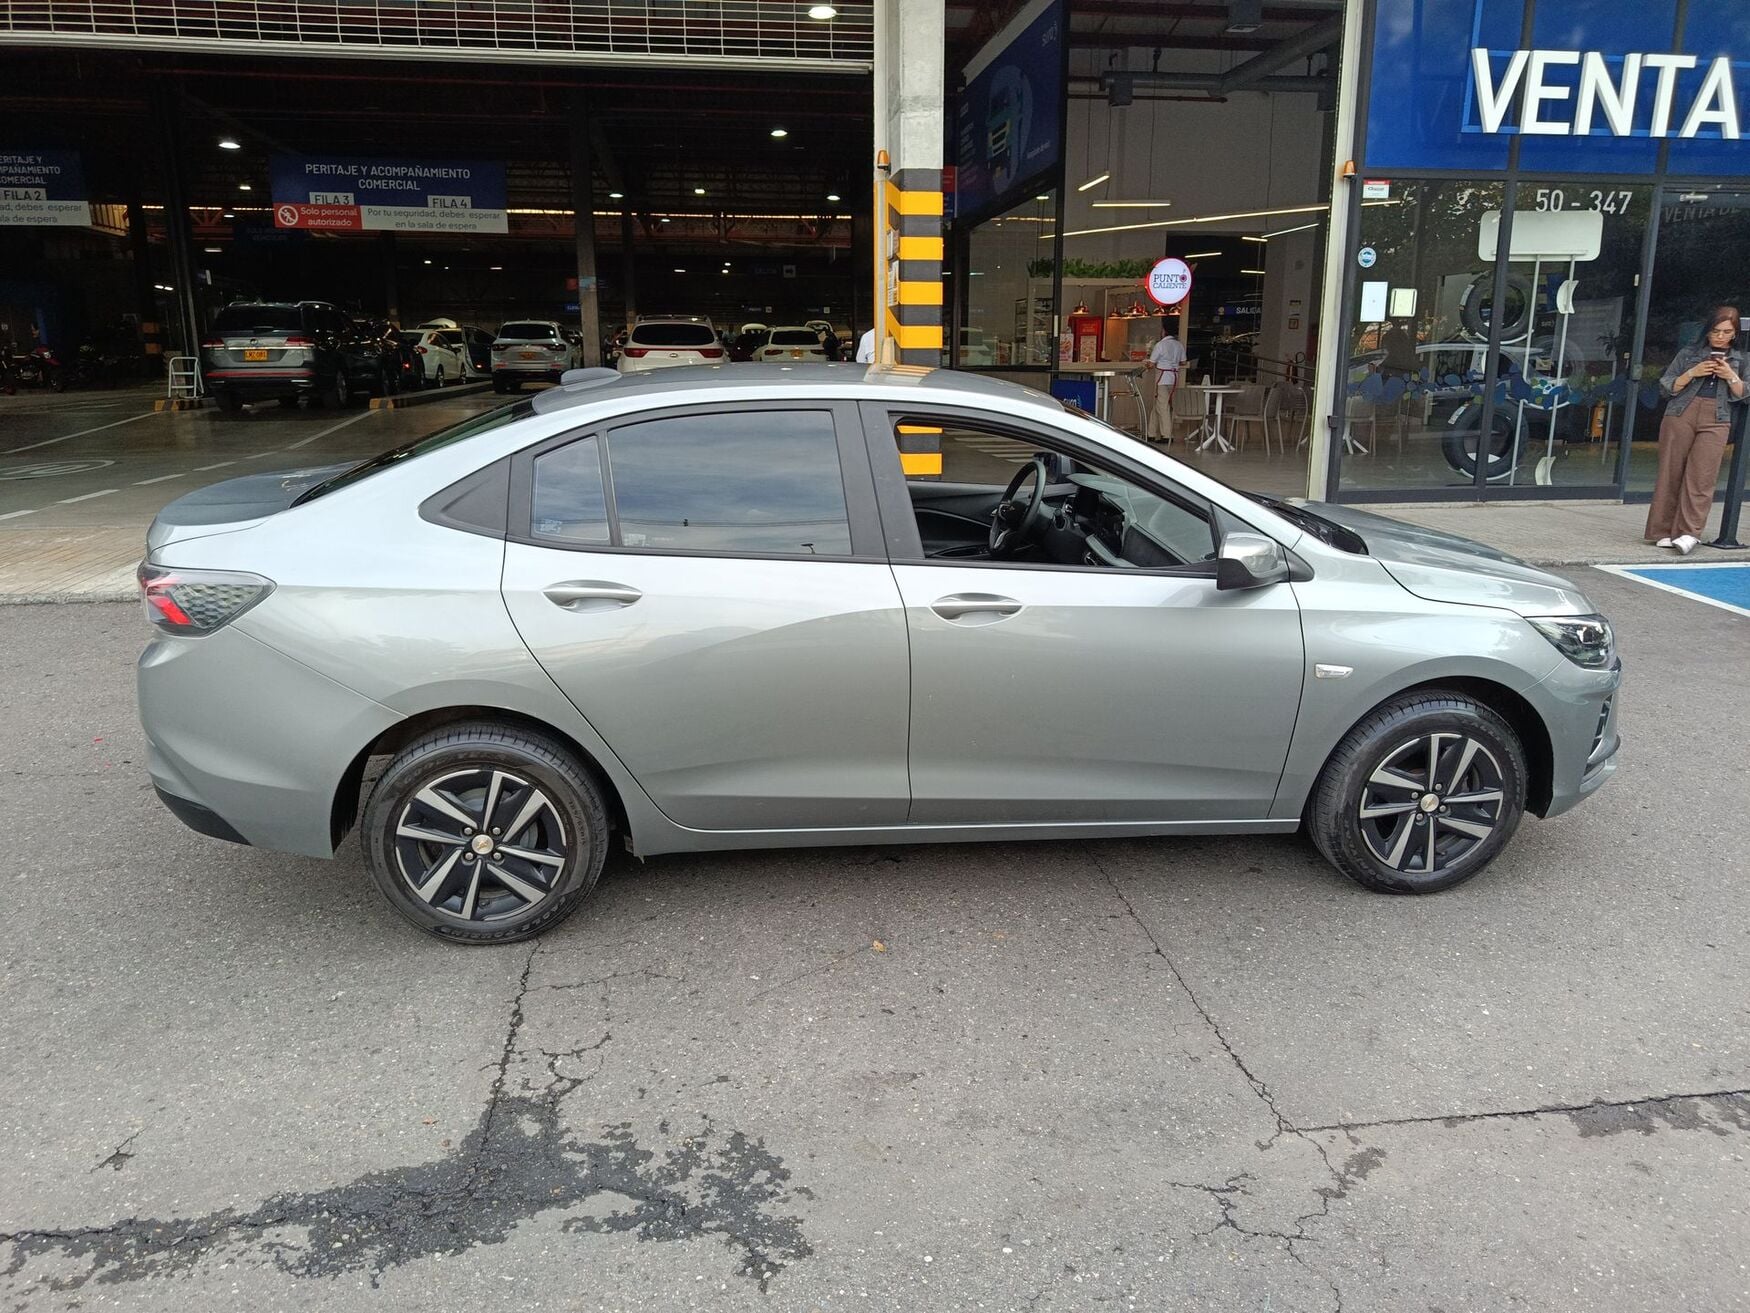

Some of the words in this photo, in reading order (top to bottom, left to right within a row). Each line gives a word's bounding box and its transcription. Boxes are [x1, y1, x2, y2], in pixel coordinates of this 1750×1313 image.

[1471, 48, 1740, 140] VENTA
[305, 164, 358, 175] PERITAJE
[360, 166, 368, 175] Y
[370, 165, 471, 180] ACOMPAÑAMIENTO
[358, 179, 421, 191] COMERCIAL
[4, 190, 31, 200] FILA
[34, 190, 41, 200] 2
[314, 195, 341, 205] FILA
[343, 195, 350, 205] 3
[432, 198, 458, 208] FILA
[460, 199, 467, 208] 4
[1535, 189, 1563, 213] 50
[1589, 190, 1633, 215] 347
[15, 203, 43, 211] debes
[47, 204, 82, 213] esperar
[300, 208, 320, 216] Solo
[321, 208, 358, 217] personal
[367, 208, 381, 216] Por
[439, 210, 465, 218] debes
[469, 212, 500, 220] esperar
[308, 218, 352, 227] autorizado
[435, 221, 447, 229] de
[448, 223, 477, 231] espera
